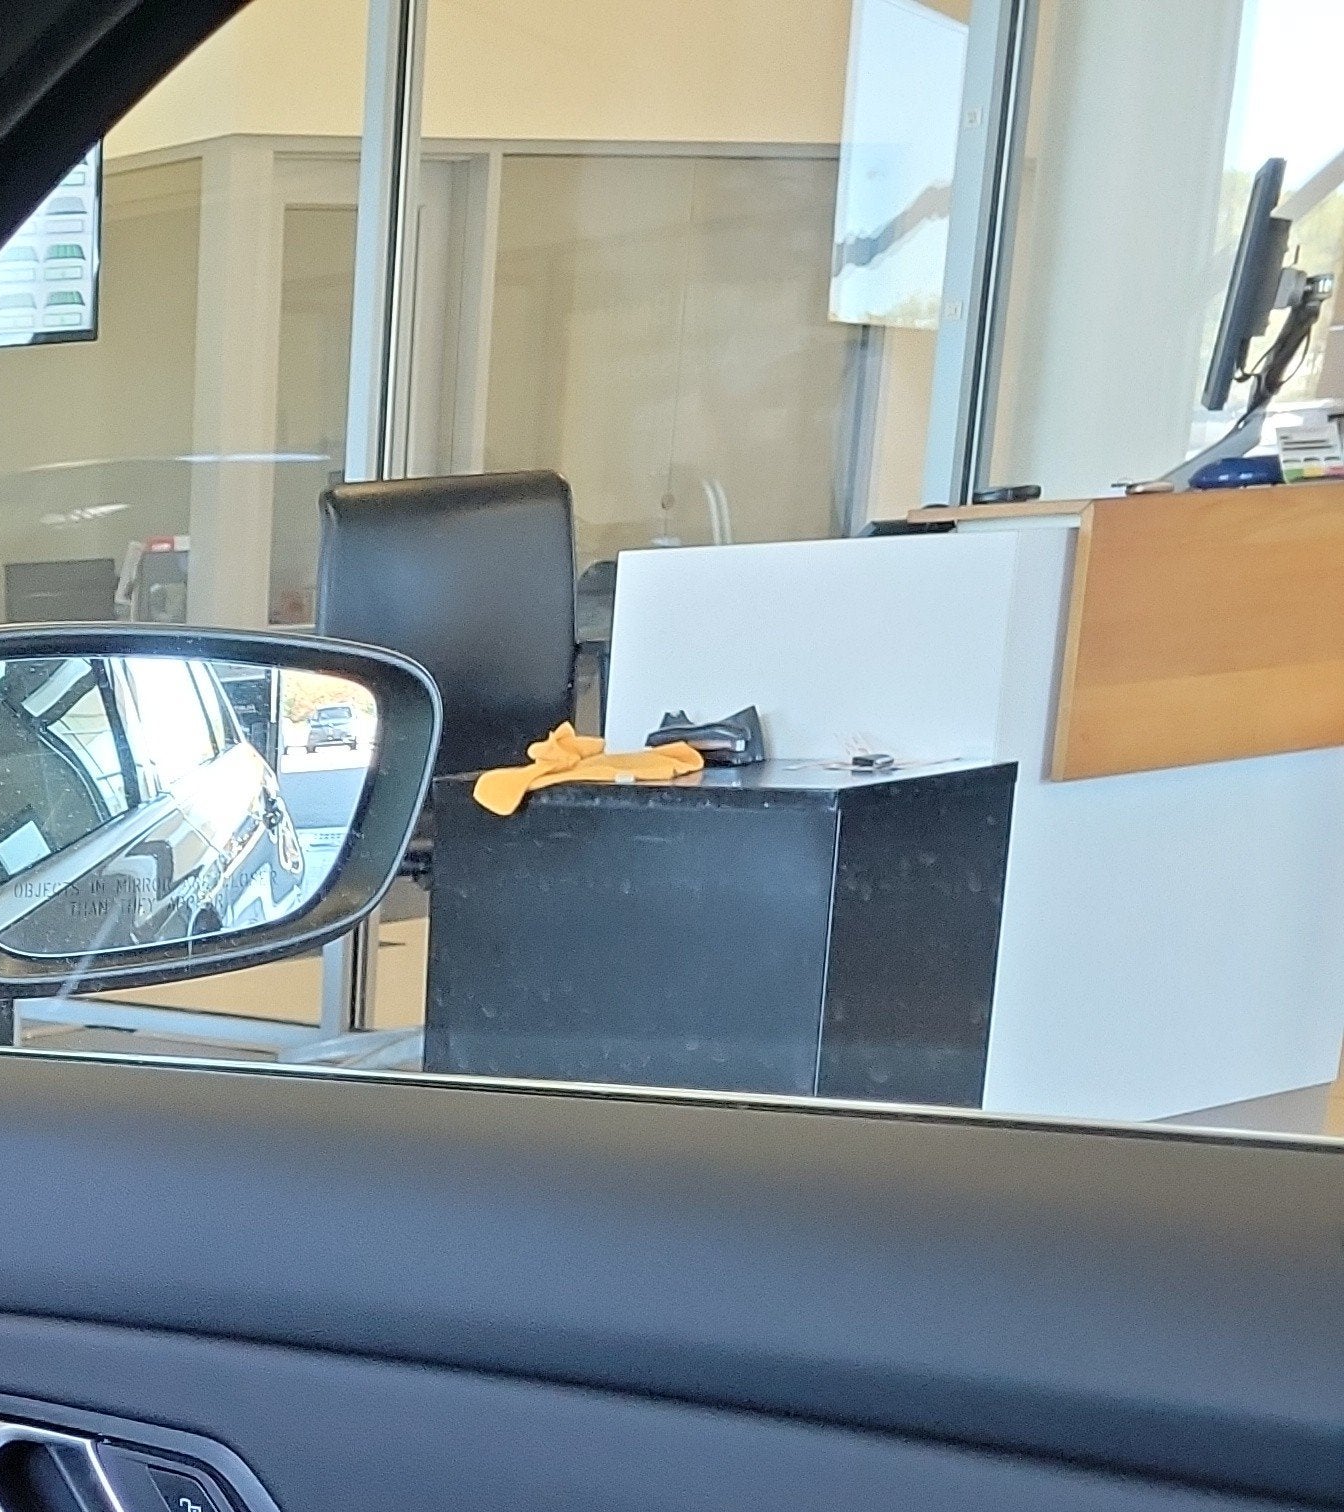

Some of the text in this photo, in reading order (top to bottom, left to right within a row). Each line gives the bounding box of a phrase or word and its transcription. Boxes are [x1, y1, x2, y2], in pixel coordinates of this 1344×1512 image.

[14, 881, 79, 898] OBJECTS
[90, 879, 105, 894] IN
[116, 876, 172, 894] MIRROR
